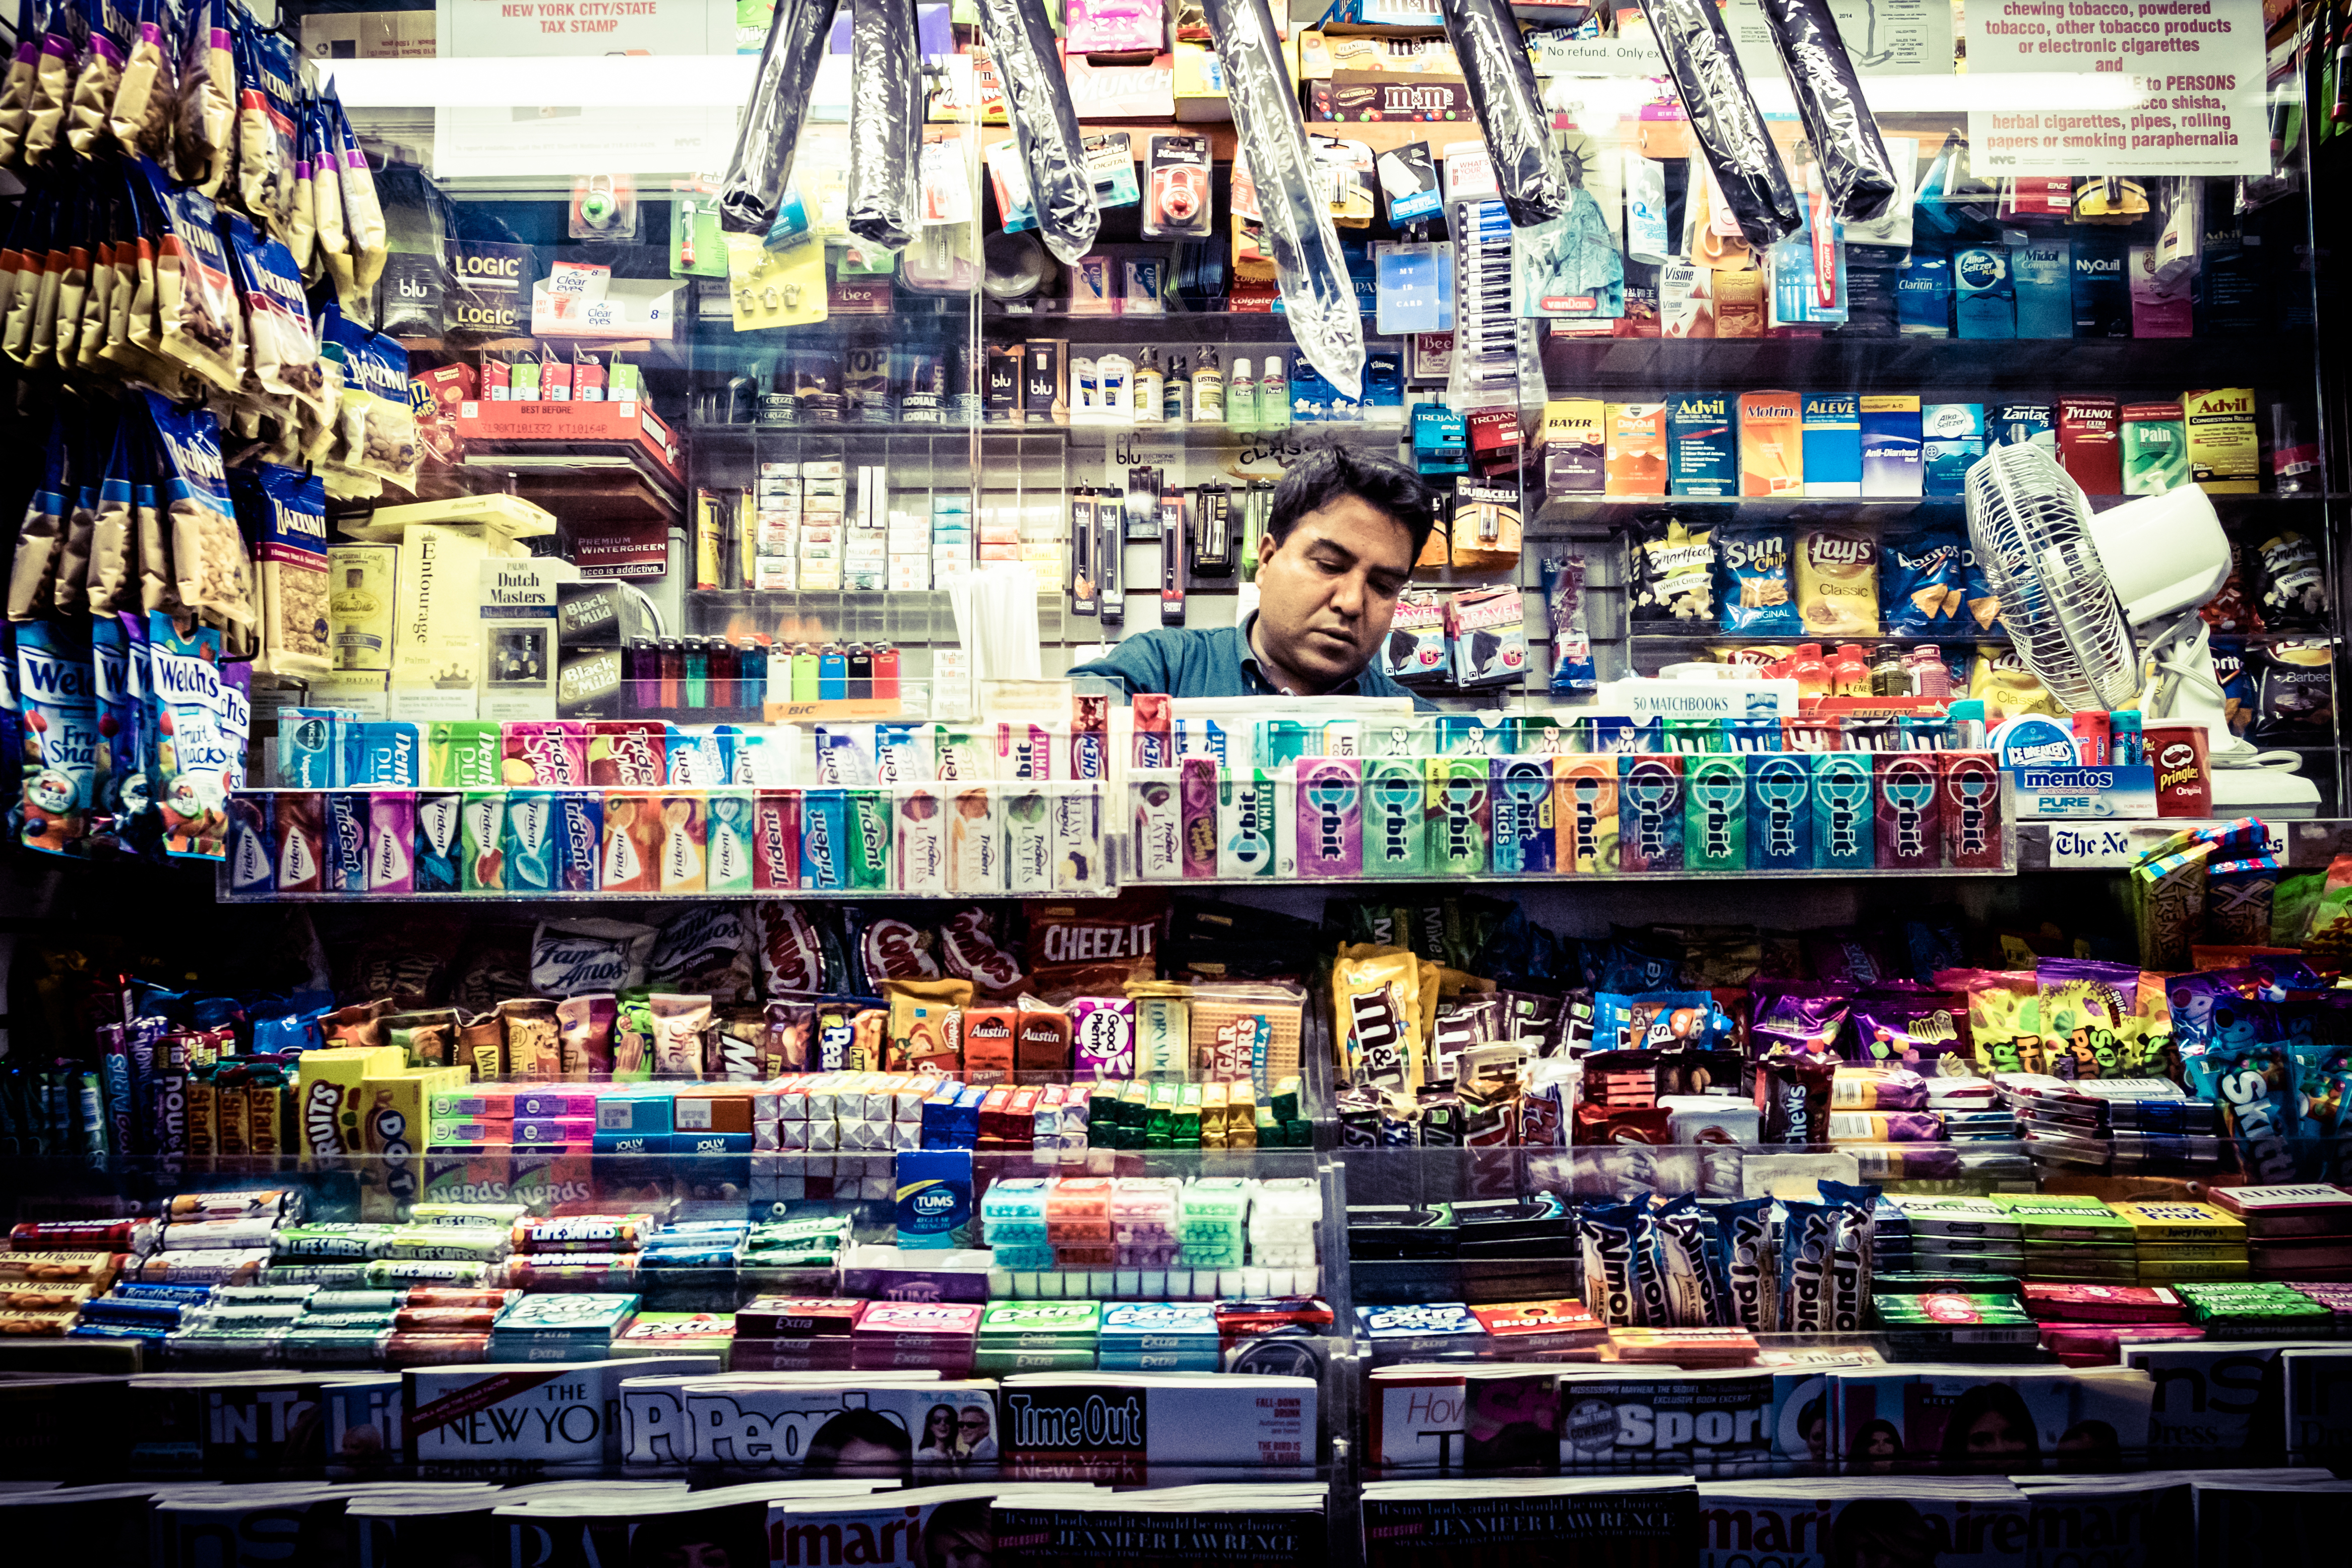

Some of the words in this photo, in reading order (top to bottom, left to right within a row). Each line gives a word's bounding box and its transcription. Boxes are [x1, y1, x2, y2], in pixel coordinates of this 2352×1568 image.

[503, 4, 534, 17] NEW
[537, 4, 575, 17] YORK
[579, 2, 656, 16] CITY/STATE
[2004, 2, 2065, 17] chewing
[2069, 2, 2133, 17] tobacco,
[2139, 2, 2211, 17] powdered
[541, 20, 565, 34] TAX
[571, 20, 618, 33] STAMP
[1986, 21, 2051, 37] tobacco,
[2056, 20, 2095, 34] other
[2099, 20, 2160, 34] tobacco
[2164, 19, 2232, 36] products
[1340, 42, 1364, 51] PEANUT
[1548, 46, 1566, 57] No
[1569, 45, 1610, 58] refund.
[1617, 46, 1642, 59] Only
[2018, 42, 2033, 53] or
[2038, 39, 2117, 53] electronic
[2121, 38, 2199, 54] cigarettes
[2095, 57, 2123, 73] and
[2147, 77, 2161, 91] to
[2167, 75, 2236, 91] PERSONS
[2172, 95, 2226, 110] shisha,
[1993, 114, 2039, 130] herbal
[2045, 114, 2126, 131] cigarettes,
[2131, 114, 2176, 131] pipes,
[2181, 113, 2231, 131] rolling
[1987, 135, 2038, 151] papers
[2043, 135, 2059, 148] or
[2063, 133, 2126, 150] smoking
[2132, 132, 2238, 149] paraphernalia
[1094, 157, 1128, 170] DIGITAL
[1459, 159, 1489, 168] WHAT'S
[1989, 156, 2016, 165] NYC
[1460, 166, 1481, 175] YOUR
[1965, 256, 1987, 266] Alka-
[2025, 249, 2059, 262] Midol
[456, 257, 520, 277] LOGIC
[1962, 263, 1994, 274] Seltzer
[2076, 259, 2120, 272] NyQuil
[557, 275, 588, 286] Clear
[1665, 267, 1694, 281] Visine
[399, 279, 427, 297] blu
[1899, 279, 1932, 290] Claritin
[842, 288, 872, 301] Bee
[1232, 296, 1271, 306] Colgate
[1396, 299, 1422, 307] CARD
[458, 307, 514, 325] LOGIC
[536, 306, 548, 315] ME!
[588, 308, 612, 318] Clear
[589, 317, 611, 328] eyes
[845, 353, 888, 372] TOP
[1371, 361, 1395, 370] Kleenex
[434, 366, 459, 378] Peanut
[436, 372, 460, 382] Butter
[521, 405, 539, 414] BEST
[542, 406, 574, 415] BEFORE:
[903, 398, 937, 408] KODIAK
[1676, 399, 1726, 416] Advil
[1805, 401, 1855, 415] ALEVE
[2196, 398, 2247, 414] Advil
[1415, 413, 1461, 422] TROJAN
[1745, 405, 1793, 419] Motrin
[1939, 414, 1960, 423] Alka-
[2002, 407, 2050, 421] Zantac
[2065, 406, 2114, 420] TYLENOL
[1549, 418, 1592, 428] BAYER
[1617, 419, 1656, 429] DayQuil
[1937, 419, 1964, 429] Seltzer
[2039, 419, 2049, 427] 75
[2191, 417, 2234, 425] CONGESTION
[2235, 415, 2254, 423] RELIEF
[2140, 427, 2171, 443] Pain
[1117, 447, 1141, 465] blu
[1866, 448, 1918, 458] Anti-Diarrheal
[1458, 486, 1518, 499] DURACELL
[275, 498, 326, 539] BAZZINI
[1101, 512, 1116, 523] blu
[579, 536, 631, 545] PREMIUM
[582, 543, 666, 554] WINTERGREEN
[1648, 544, 1714, 566] Smartfood
[1725, 535, 1783, 571] Sun
[332, 552, 361, 561] Natural
[364, 552, 381, 562] Leaf
[507, 562, 528, 571] PALMA
[616, 563, 661, 574] addictive.
[498, 572, 539, 588] Dutch
[1658, 580, 1680, 591] WHITE
[413, 542, 436, 647] Entourage
[490, 588, 546, 604] Masters
[1819, 583, 1868, 598] Classic
[565, 594, 609, 616] Black
[576, 604, 612, 628] Mild
[158, 658, 219, 698] Welch's
[787, 705, 817, 716] BIC
[1634, 697, 1646, 710] 50
[1649, 697, 1728, 711] MATCHBOOKS
[2008, 746, 2021, 761] ICE
[2023, 741, 2071, 760] BREAKERS
[2024, 769, 2114, 788] mentos
[2159, 765, 2198, 792] Pringles
[2176, 786, 2201, 796] Original
[2038, 797, 2089, 807] PURE
[1497, 804, 1514, 846] kids
[332, 795, 359, 872] Trident
[761, 809, 790, 888] Trident
[1044, 923, 1155, 962] CHEEZ-IT
[969, 1022, 1010, 1040] Austin
[1091, 1013, 1104, 1055] Plenty
[1104, 1014, 1121, 1052] Good
[615, 1137, 645, 1151] JOLLY
[2238, 1185, 2338, 1202] ALTOIDS
[916, 1195, 954, 1208] TUMS
[1905, 1202, 2006, 1215] SPEARMINT
[2016, 1207, 2113, 1218] DOUBLEMINT
[2167, 1227, 2193, 1238] Juicy
[2194, 1227, 2218, 1238] Fruit
[866, 1306, 974, 1322] Extra
[988, 1303, 1092, 1322] Extra
[1570, 1385, 1620, 1394] MISSISSIPPI
[1622, 1385, 1655, 1394] MAYHEM,
[1658, 1385, 1673, 1394] THE
[1675, 1385, 1699, 1394] SEQUEL
[1256, 1398, 1301, 1408] FALL-DOWN
[1653, 1395, 1694, 1405] EXCLUSIVE
[1696, 1395, 1717, 1404] BOOK
[1719, 1394, 1751, 1403] EXCERPT
[1009, 1394, 1082, 1447] Time
[1084, 1394, 1141, 1447] Out
[1274, 1409, 1301, 1419] DRUNK
[1056, 1529, 1172, 1550] JENNIFER
[1173, 1530, 1299, 1552] LAWRENCE
